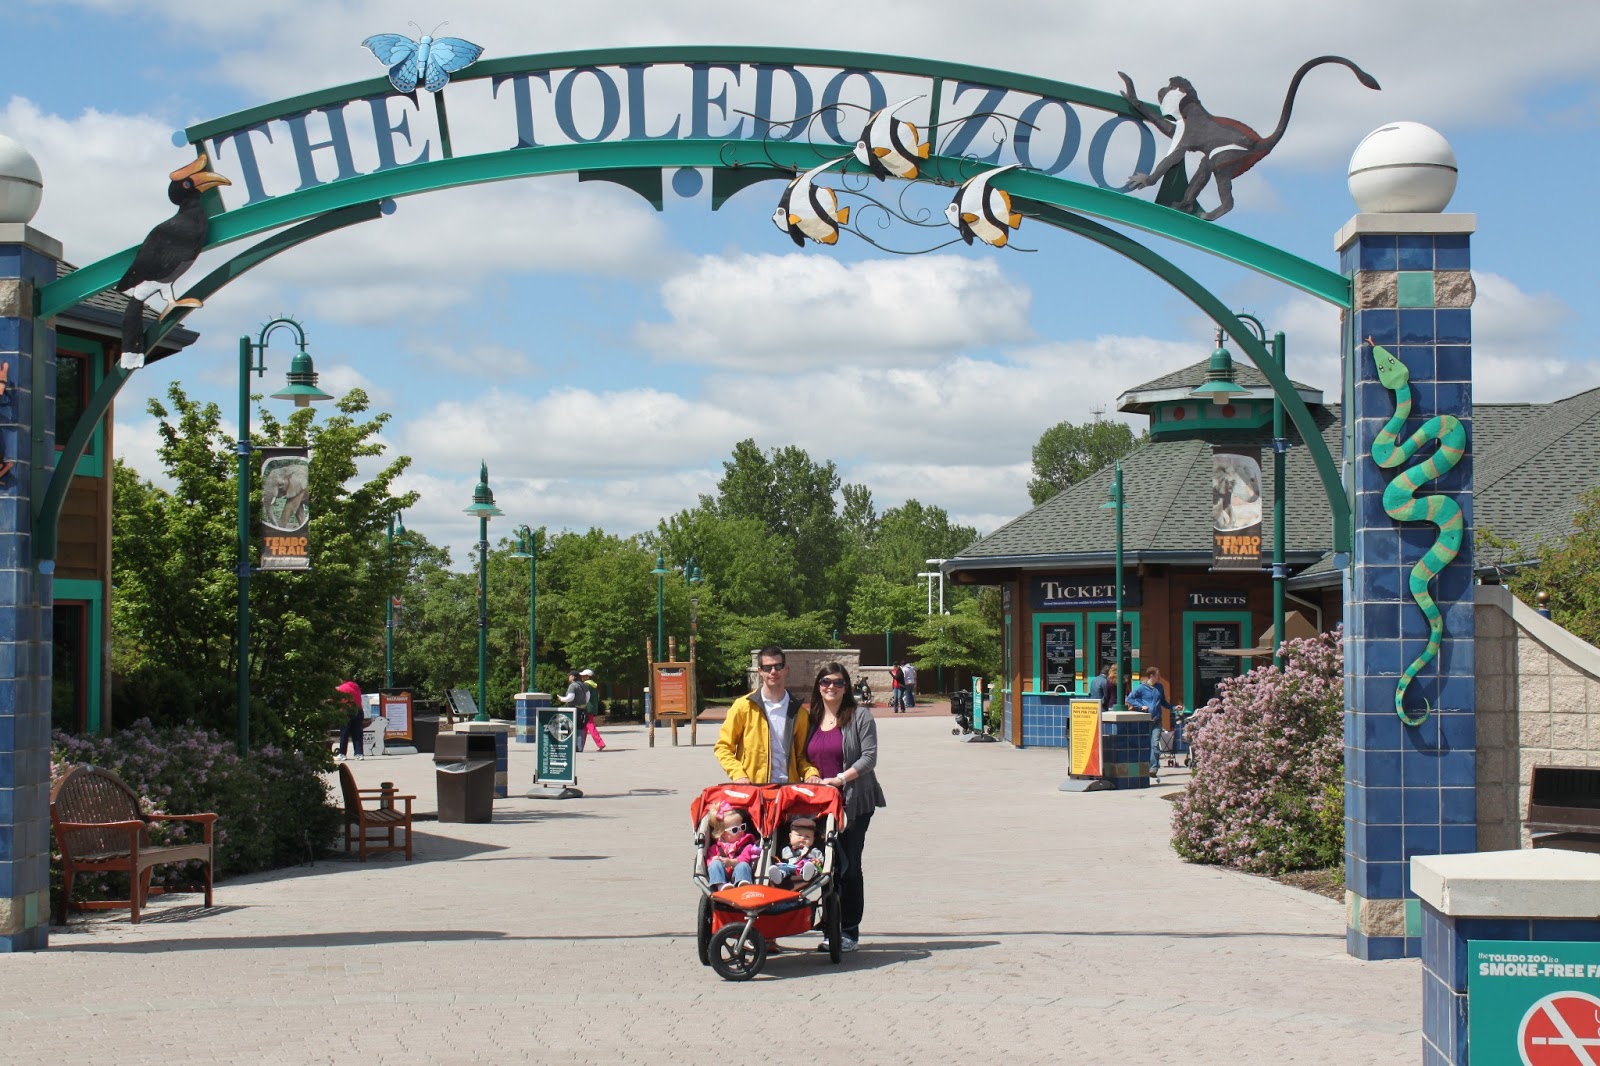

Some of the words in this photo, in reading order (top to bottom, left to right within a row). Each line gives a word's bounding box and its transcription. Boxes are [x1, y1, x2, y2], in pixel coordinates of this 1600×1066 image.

[211, 93, 430, 207] THE
[492, 63, 888, 150] TOLEDO
[942, 82, 1157, 194] ZOO
[264, 537, 308, 547] TEMBO
[1215, 536, 1261, 546] TEMBO
[270, 546, 308, 556] TRAIL
[1222, 545, 1260, 555] TRAIL
[1489, 954, 1526, 963] TOLEDO
[1527, 955, 1548, 963] ZOO
[1479, 963, 1585, 977] SMOKE-FREE
